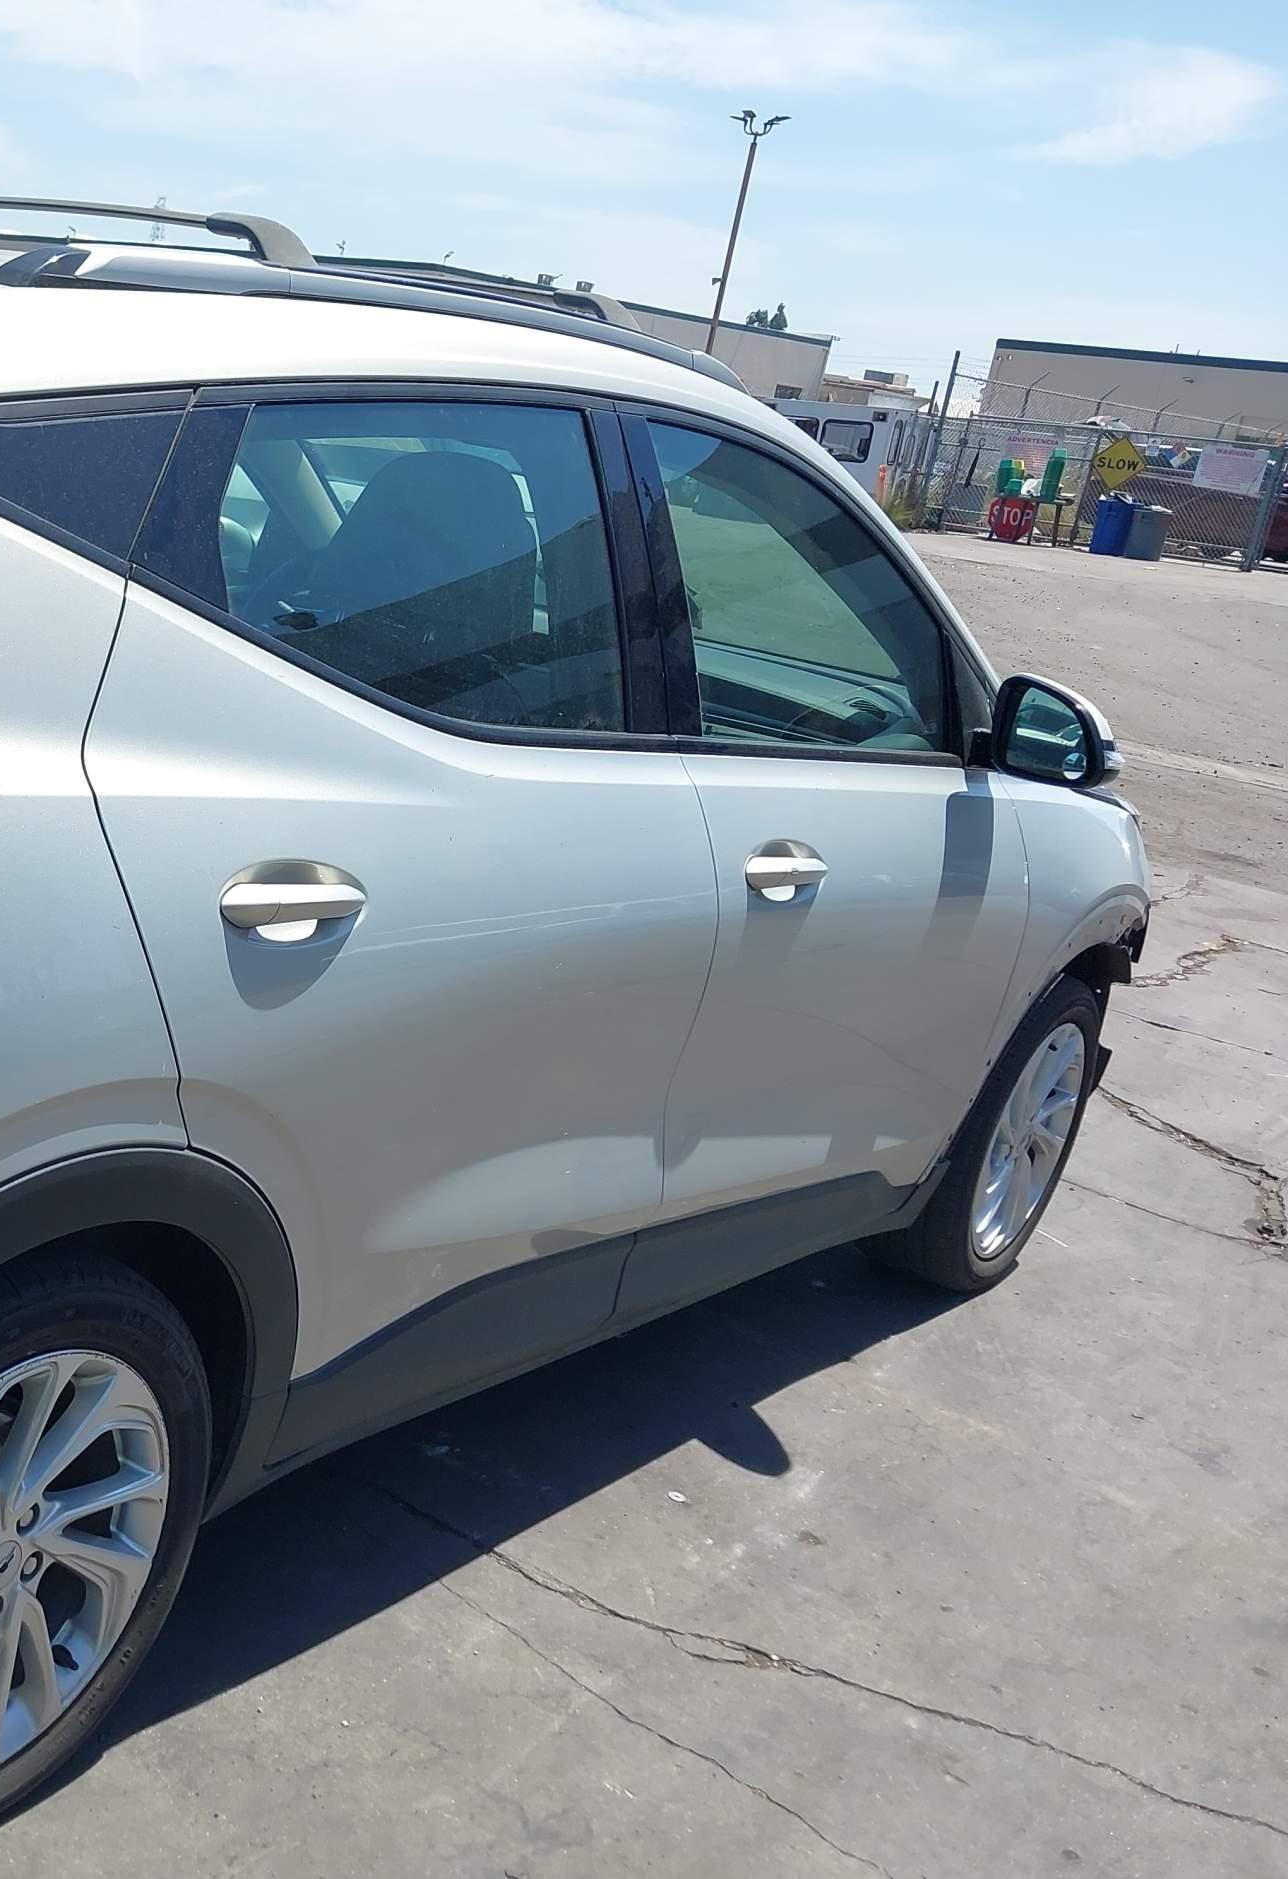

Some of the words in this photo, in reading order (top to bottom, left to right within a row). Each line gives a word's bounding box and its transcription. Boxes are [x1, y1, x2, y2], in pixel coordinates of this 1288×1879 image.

[1007, 436, 1059, 446] ADVERTENCIA
[1215, 447, 1256, 459] WARNING
[1096, 456, 1140, 472] SLOW
[991, 505, 1033, 527] STOP
